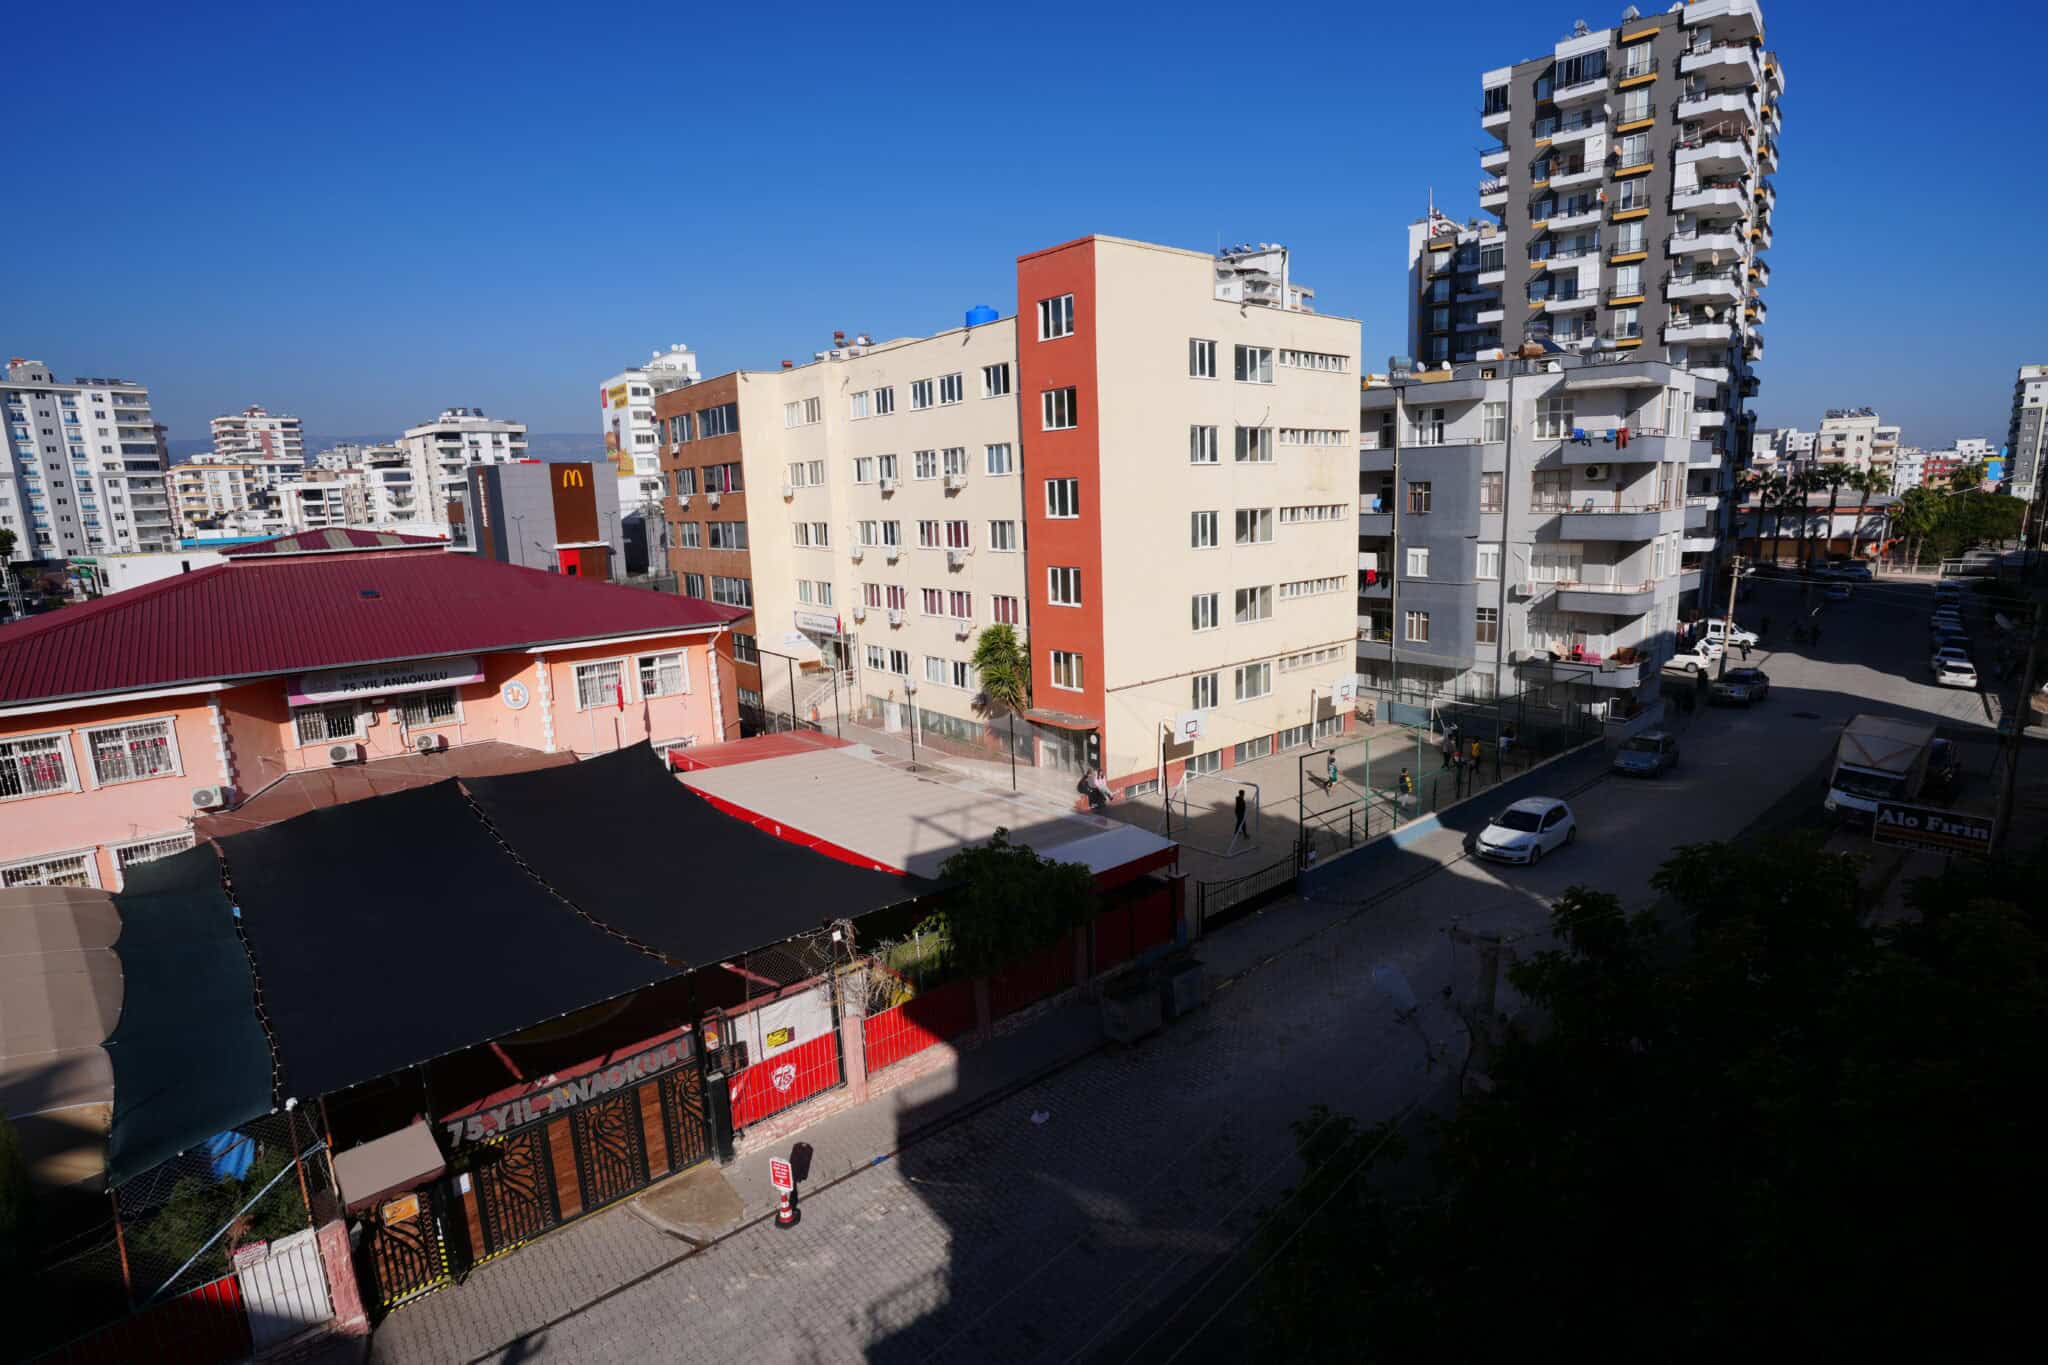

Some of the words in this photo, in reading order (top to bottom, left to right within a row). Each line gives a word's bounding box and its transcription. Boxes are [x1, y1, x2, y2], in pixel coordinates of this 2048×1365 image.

[363, 679, 379, 691] YIL
[383, 672, 448, 687] ANAOKULU
[1878, 807, 1920, 828] Alo
[547, 1036, 692, 1114] ANAOKULU
